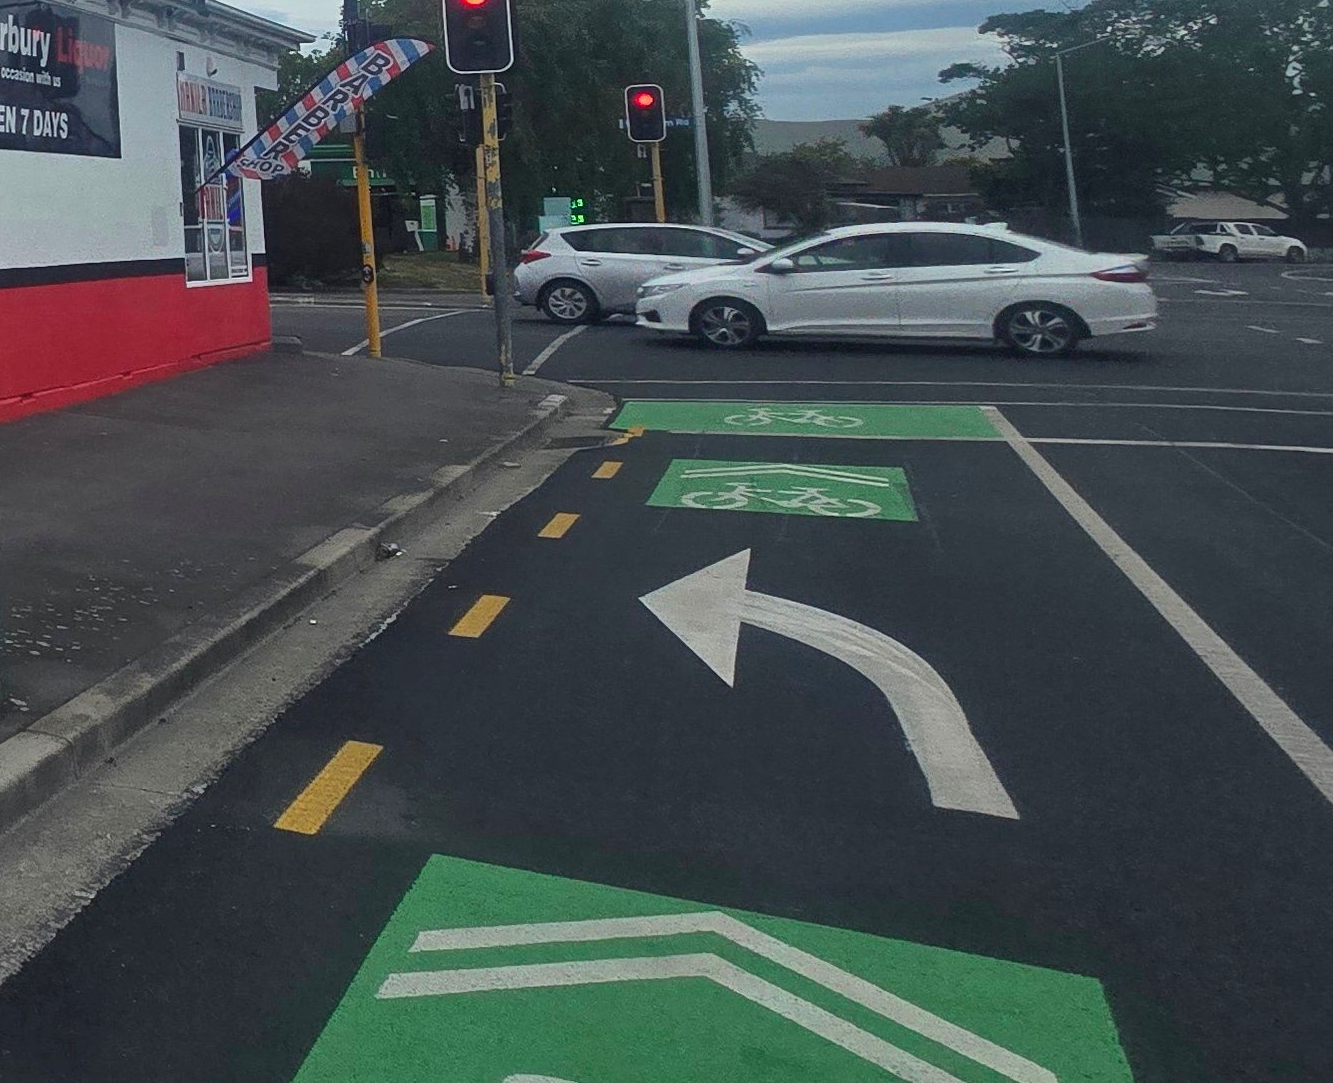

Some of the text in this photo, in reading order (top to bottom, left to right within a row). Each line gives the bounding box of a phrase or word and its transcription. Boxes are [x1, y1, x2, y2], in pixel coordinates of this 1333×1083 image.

[55, 25, 111, 74] Liquor
[0, 66, 35, 83] occasion
[36, 70, 51, 86] with
[53, 76, 61, 88] us
[263, 52, 392, 161] BARBER
[20, 108, 30, 135] 7
[33, 109, 69, 139] DAYS
[240, 157, 285, 175] SHOP
